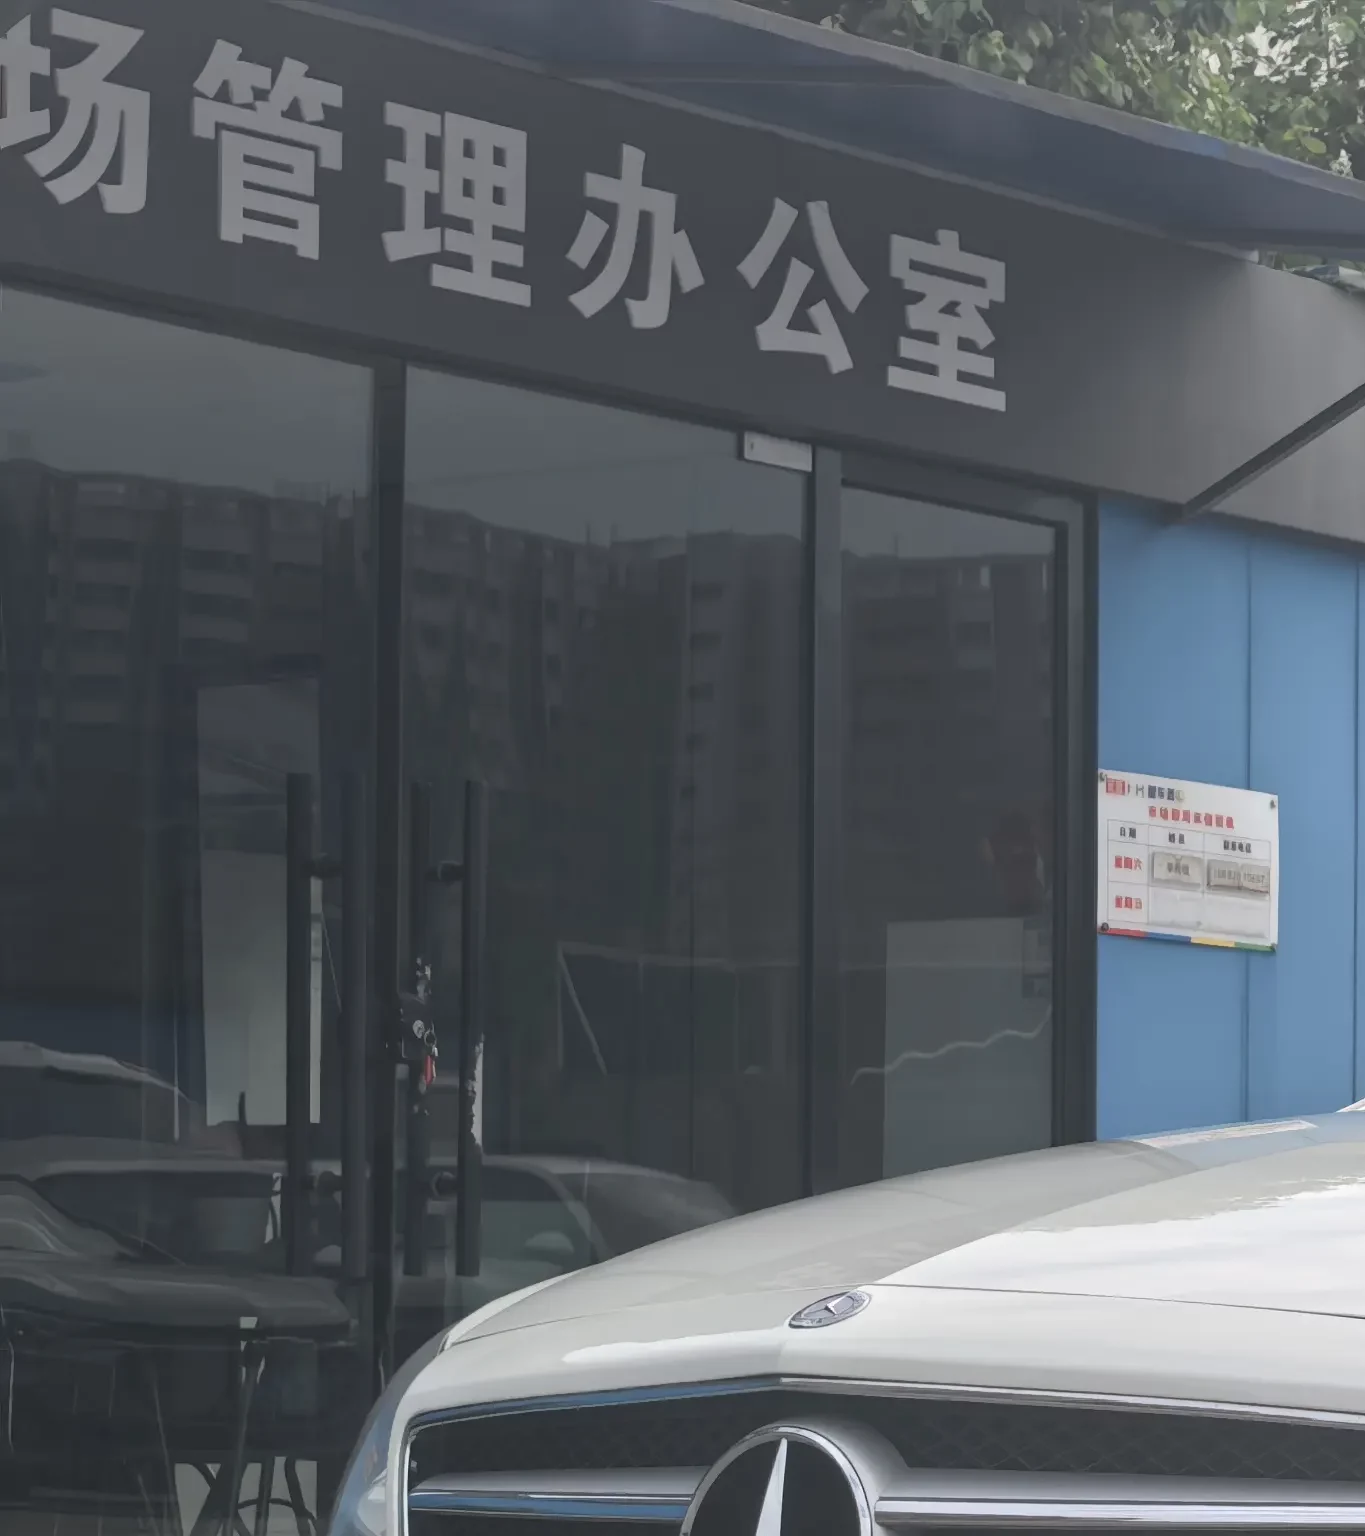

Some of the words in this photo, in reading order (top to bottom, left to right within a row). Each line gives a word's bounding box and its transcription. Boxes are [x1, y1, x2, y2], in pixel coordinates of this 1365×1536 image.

[0, 8, 1006, 412] 场管理办公室
